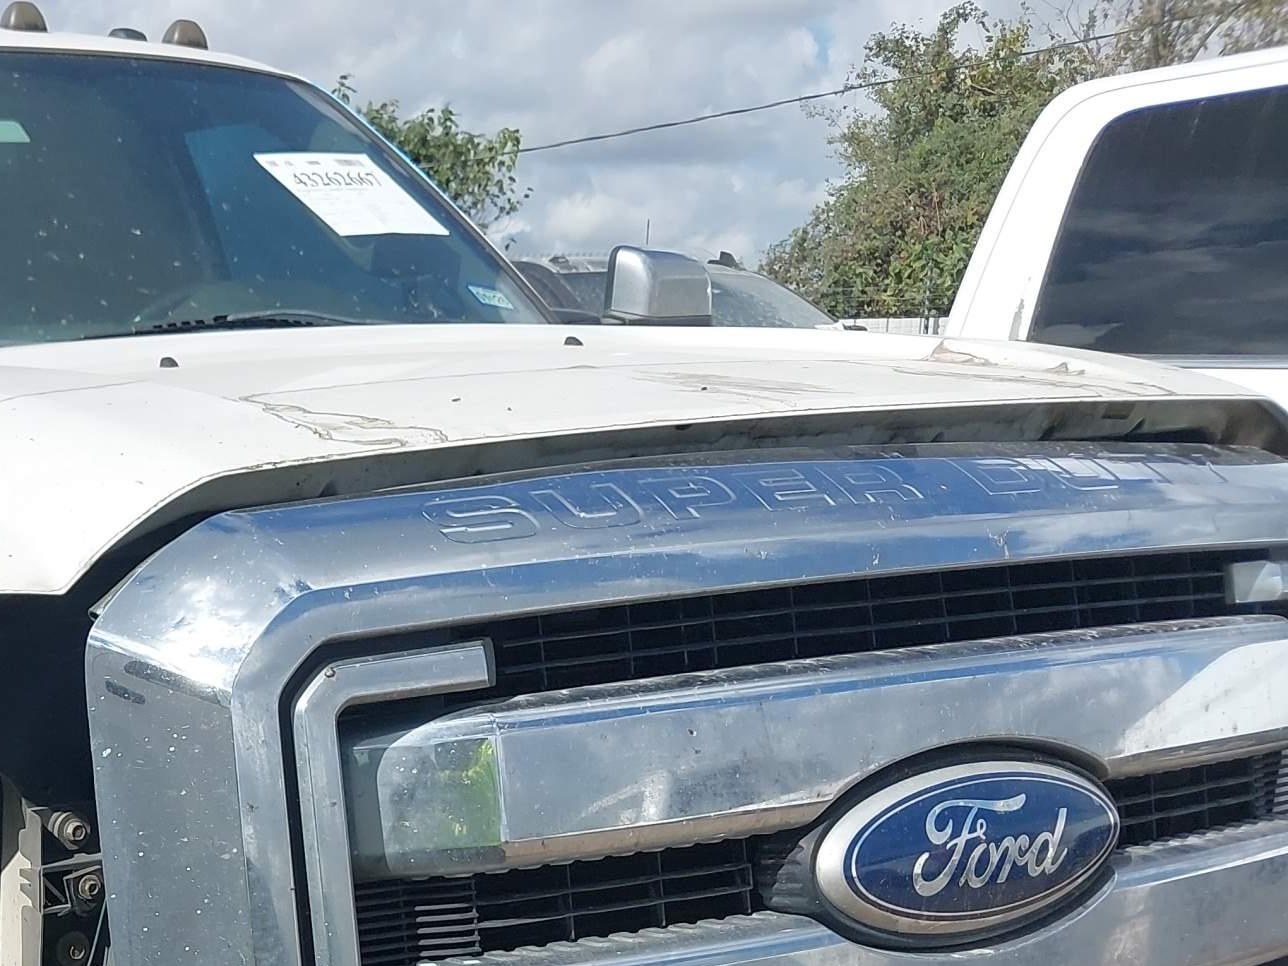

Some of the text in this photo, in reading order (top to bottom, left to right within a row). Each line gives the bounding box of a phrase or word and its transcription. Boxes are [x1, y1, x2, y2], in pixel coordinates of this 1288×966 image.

[292, 171, 383, 188] 43262667
[421, 457, 924, 544] SUPER
[912, 792, 1069, 897] Ford
